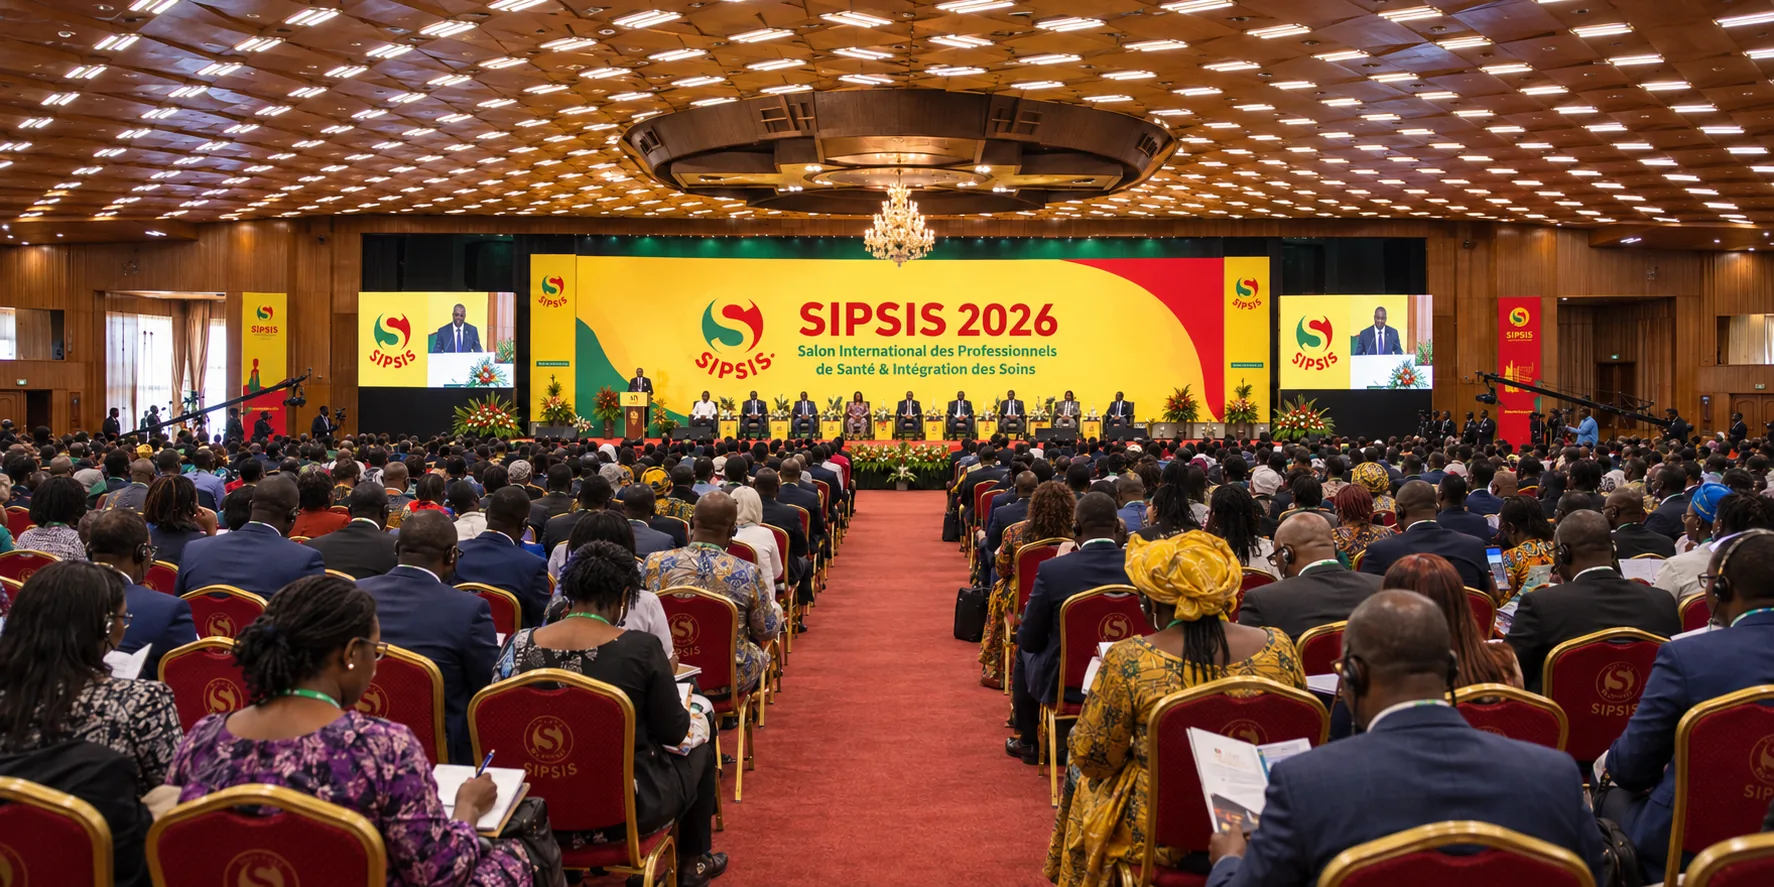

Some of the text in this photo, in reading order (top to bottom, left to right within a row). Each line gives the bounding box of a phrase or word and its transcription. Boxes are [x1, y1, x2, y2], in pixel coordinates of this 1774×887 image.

[538, 295, 567, 308] SIPSIS
[1232, 298, 1262, 310] SIPSIS
[799, 301, 1058, 337] SIPSIS 2026
[251, 325, 279, 334] SIPSIS
[1506, 331, 1533, 339] SIPSIS
[797, 344, 1058, 357] Salon International des Professionnels
[369, 349, 416, 369] SIPSIS
[1292, 351, 1338, 371] SIPSIS
[816, 362, 1036, 378] de Santé & Intégration des Soins
[523, 762, 578, 779] SIPSIS
[1743, 784, 1774, 801] SIP
